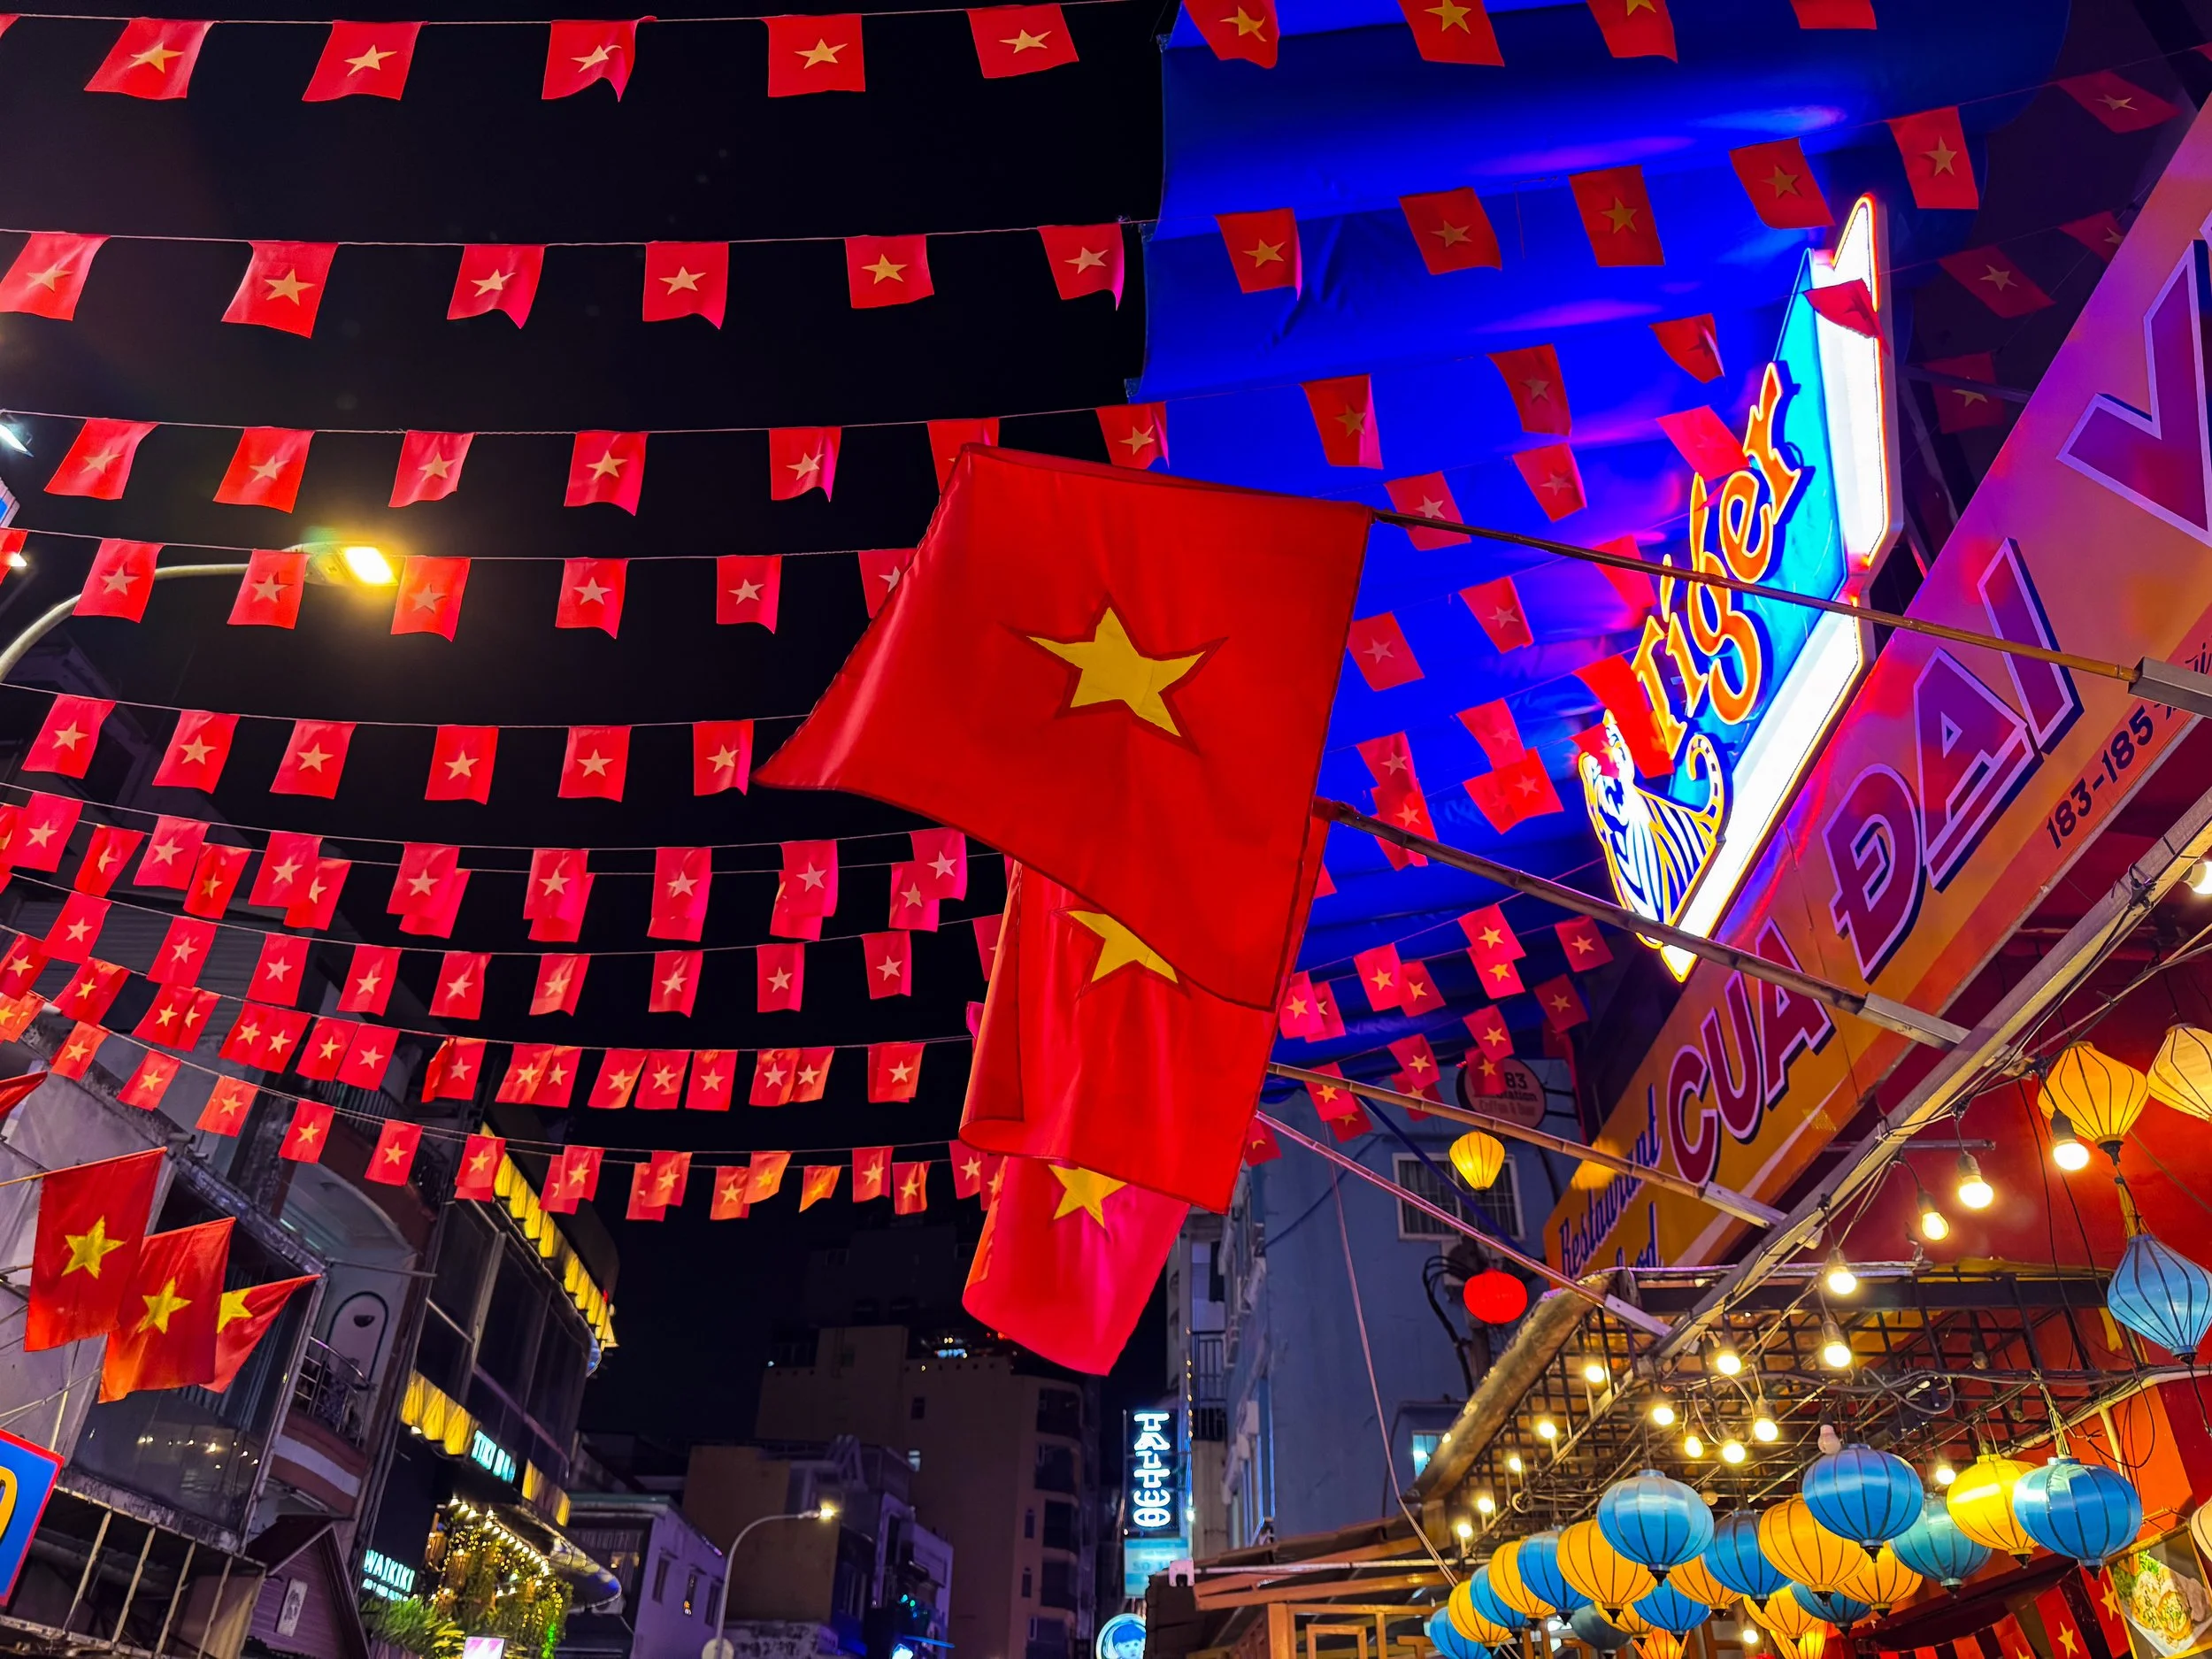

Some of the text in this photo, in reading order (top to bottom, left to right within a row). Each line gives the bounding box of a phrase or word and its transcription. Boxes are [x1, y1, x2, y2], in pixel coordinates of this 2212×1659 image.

[1631, 361, 1801, 761] Tiger
[2047, 705, 2154, 850] 183-185
[1504, 1071, 1528, 1091] 83
[1667, 916, 1835, 1187] CUA
[363, 1549, 416, 1593] WAIKIKI
